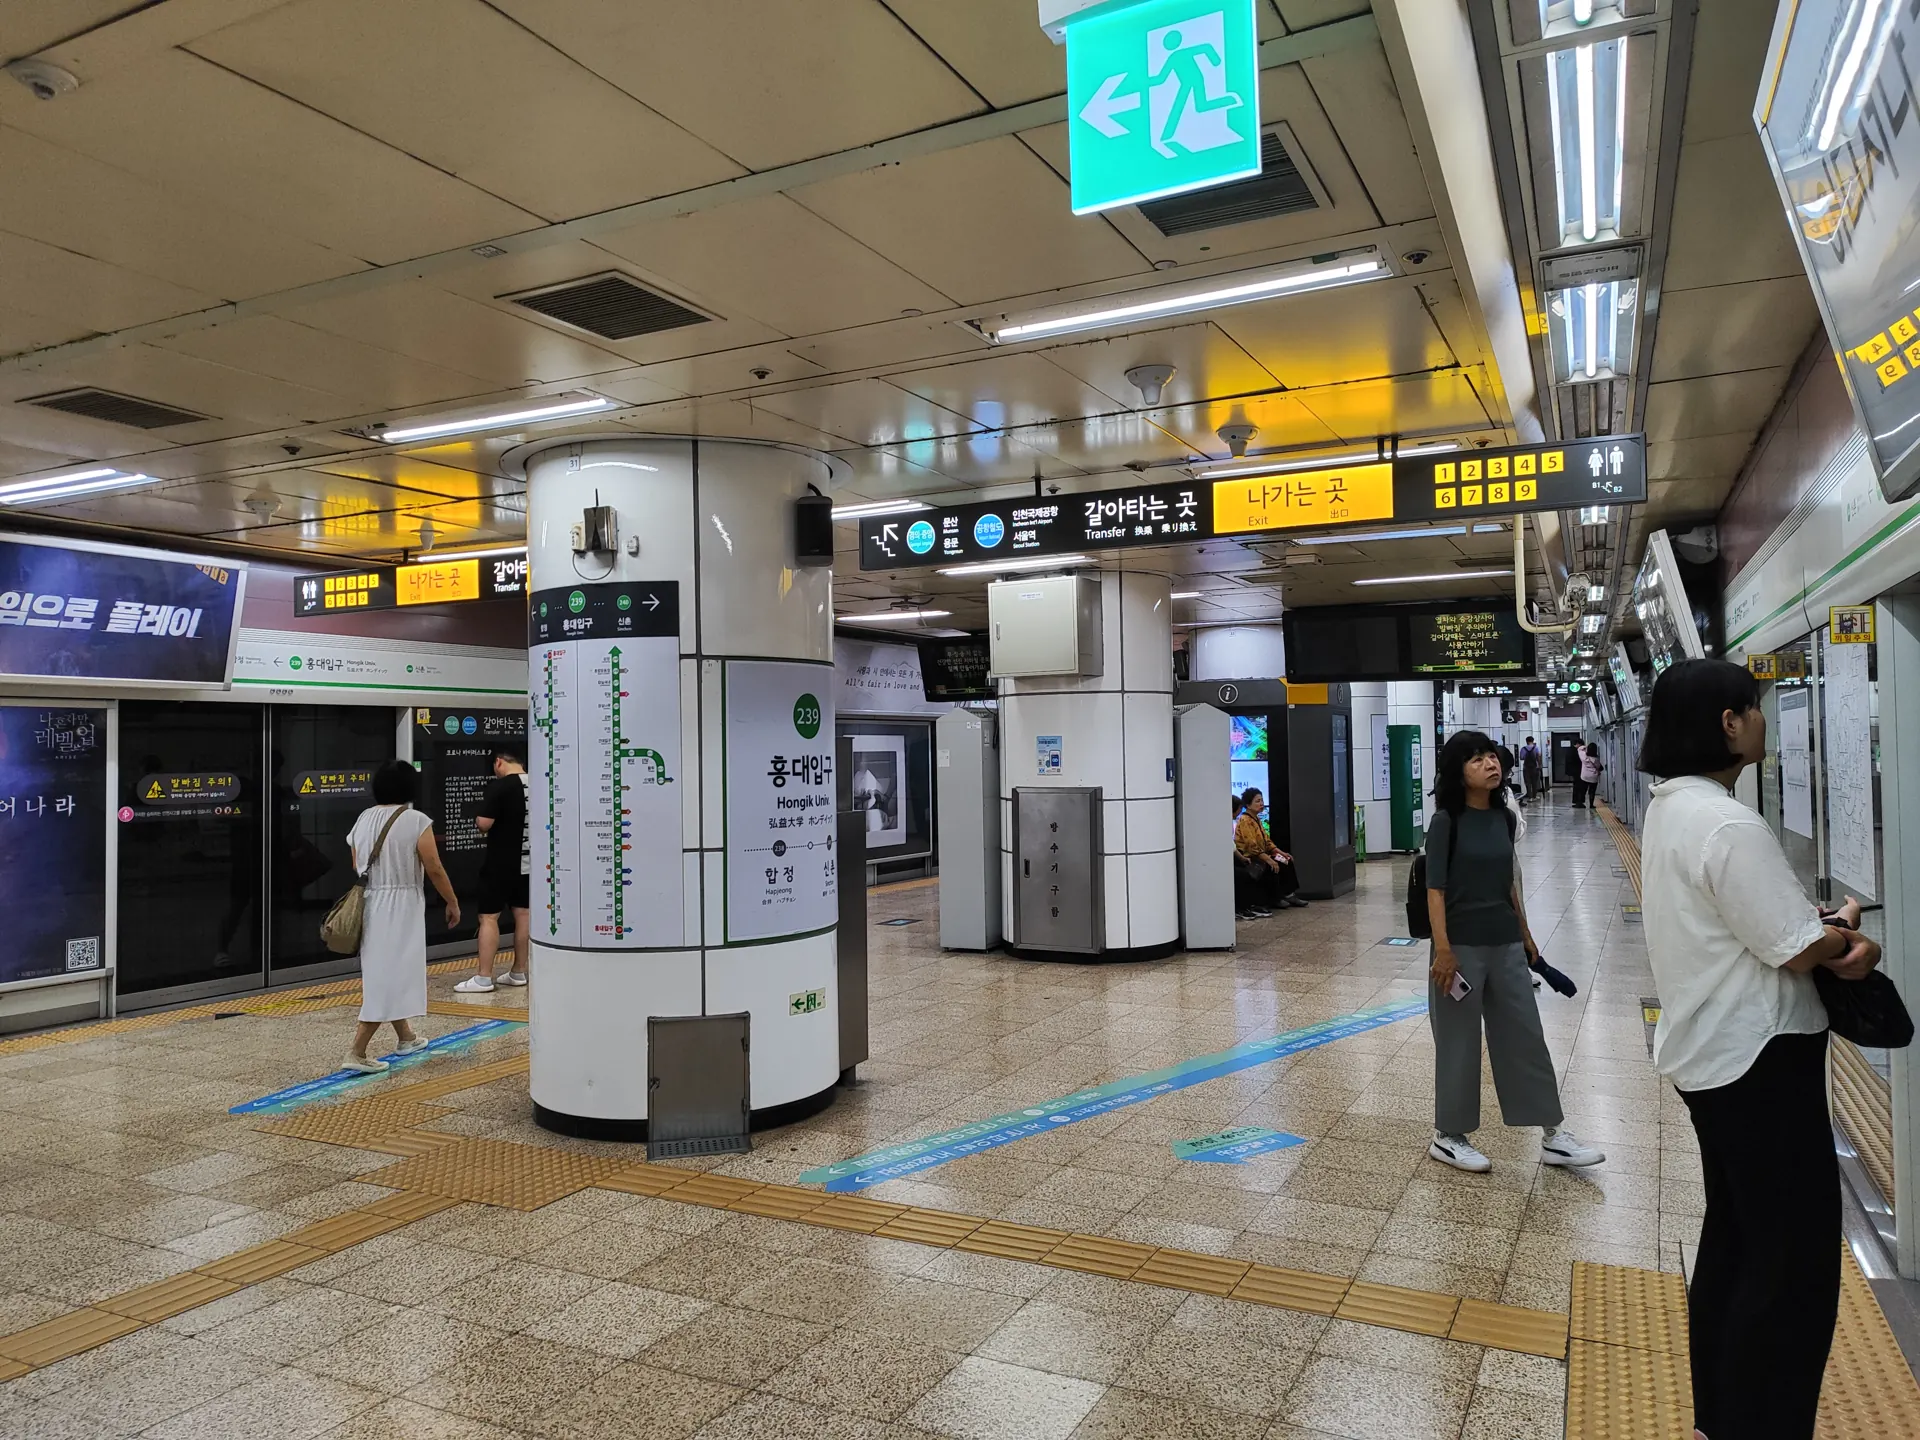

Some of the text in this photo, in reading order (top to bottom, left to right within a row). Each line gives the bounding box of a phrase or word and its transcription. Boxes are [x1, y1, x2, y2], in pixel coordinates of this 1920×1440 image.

[1441, 456, 1557, 480] 1 2 3 4 5
[1247, 477, 1349, 510] 나가는 곳
[1440, 483, 1530, 504] 6 7 8 9
[1012, 505, 1059, 521] 인천국제공항
[1084, 491, 1198, 527] 갈아타는 곳
[1329, 508, 1349, 519] 出口
[942, 516, 959, 528] 문산
[1038, 518, 1053, 526] Airport
[1248, 514, 1268, 527] Exit
[1013, 529, 1036, 541] 서울역
[1084, 526, 1126, 540] Transfer
[943, 537, 959, 549] 용문
[338, 579, 344, 590] 2
[349, 577, 355, 588] 3
[359, 576, 366, 587] 4
[370, 575, 377, 586] 5
[409, 567, 461, 590] 나가는 곳
[493, 581, 520, 593] Transfer
[327, 597, 333, 606] 6
[338, 596, 344, 606] 7
[349, 595, 355, 604] 8
[360, 593, 366, 603] 9
[409, 592, 421, 601] Exit
[570, 596, 584, 607] 239
[105, 600, 203, 639] 플레이
[562, 617, 594, 632] 홍대입구
[617, 616, 632, 626] 신촌
[1459, 613, 1496, 624] 승강장사이
[1465, 622, 1495, 632] 주의하기
[1444, 649, 1489, 658] 서울교통공사
[306, 656, 344, 671] 홍대입구
[845, 678, 920, 691] All's fair in love and
[40, 712, 52, 728] 나
[797, 707, 819, 725] 239
[483, 716, 515, 730] 갈아타는
[516, 717, 525, 729] 곳
[33, 723, 98, 753] 레벨업
[767, 754, 833, 788] 홍대입구
[170, 777, 232, 789] 발빠짐 주의!
[320, 773, 370, 784] 발빠짐 주의!
[777, 793, 830, 811] Hongik Univ.
[768, 816, 804, 829] 弘益大学
[823, 858, 835, 877] 신촌
[765, 865, 795, 885] 합정
[765, 886, 793, 897] Hapjeong
[594, 925, 614, 933] 홍대입구
